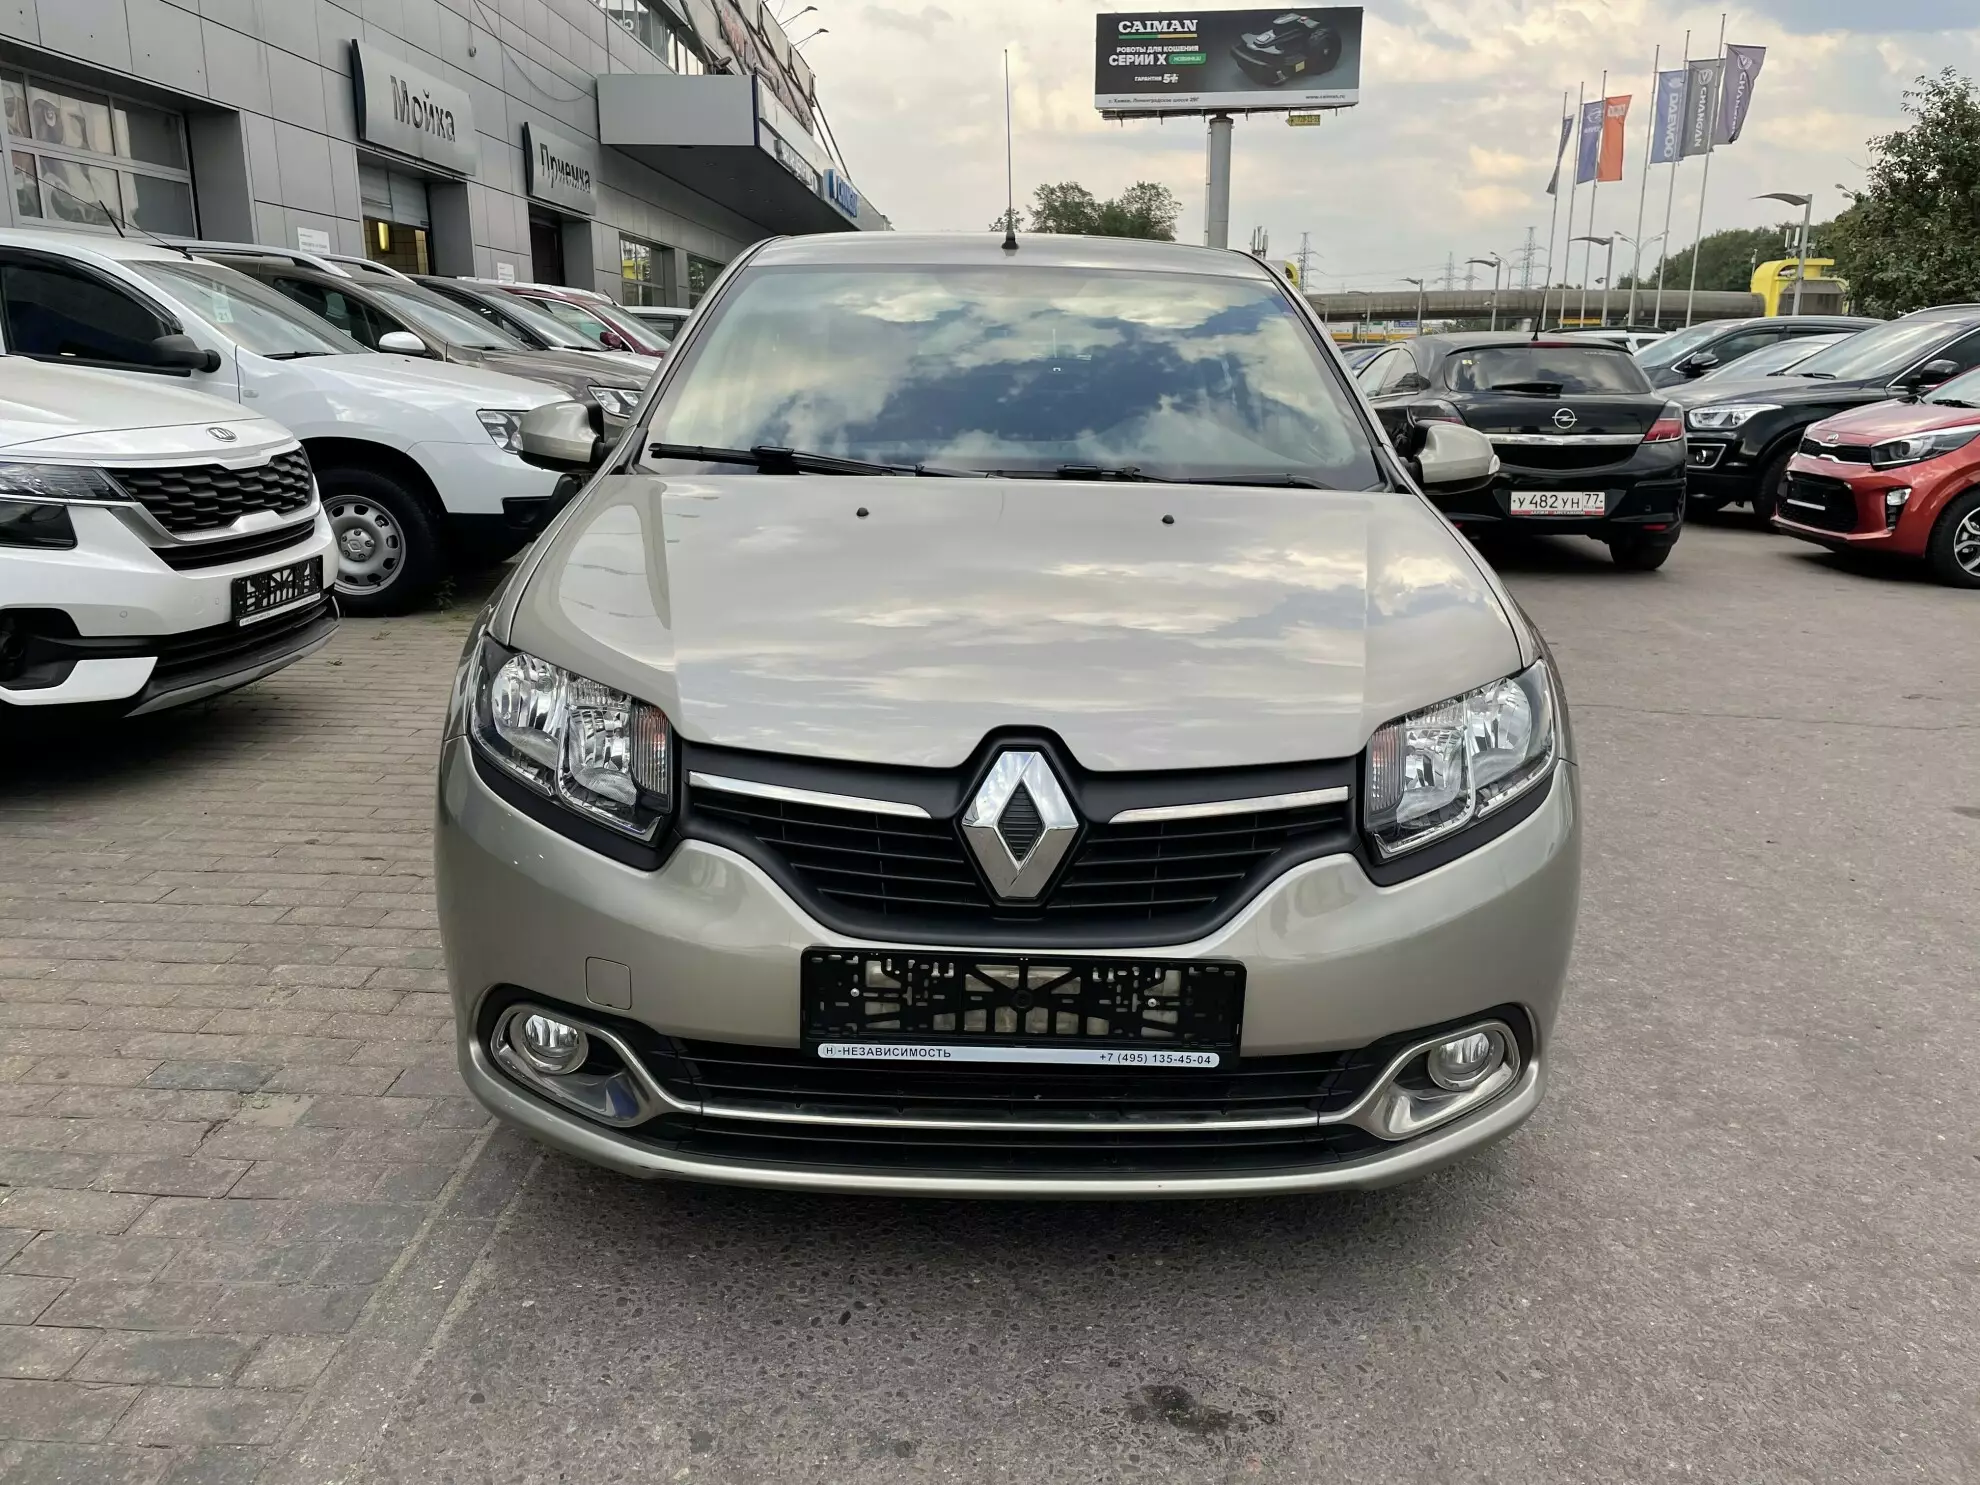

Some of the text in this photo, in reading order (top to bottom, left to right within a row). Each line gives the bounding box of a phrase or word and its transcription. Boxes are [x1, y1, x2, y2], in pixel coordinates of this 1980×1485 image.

[1118, 19, 1198, 33] CAIMAN
[1109, 54, 1154, 66] СЕРИИ
[390, 75, 456, 142] Мойка
[1694, 86, 1707, 147] CHANGAN
[1663, 93, 1680, 158] DAEWOO
[540, 143, 592, 195] Приемка
[1584, 493, 1600, 504] 77
[1099, 1053, 1114, 1063] +7
[1117, 1052, 1148, 1065] (495)
[1152, 1054, 1212, 1065] 135-45-04
